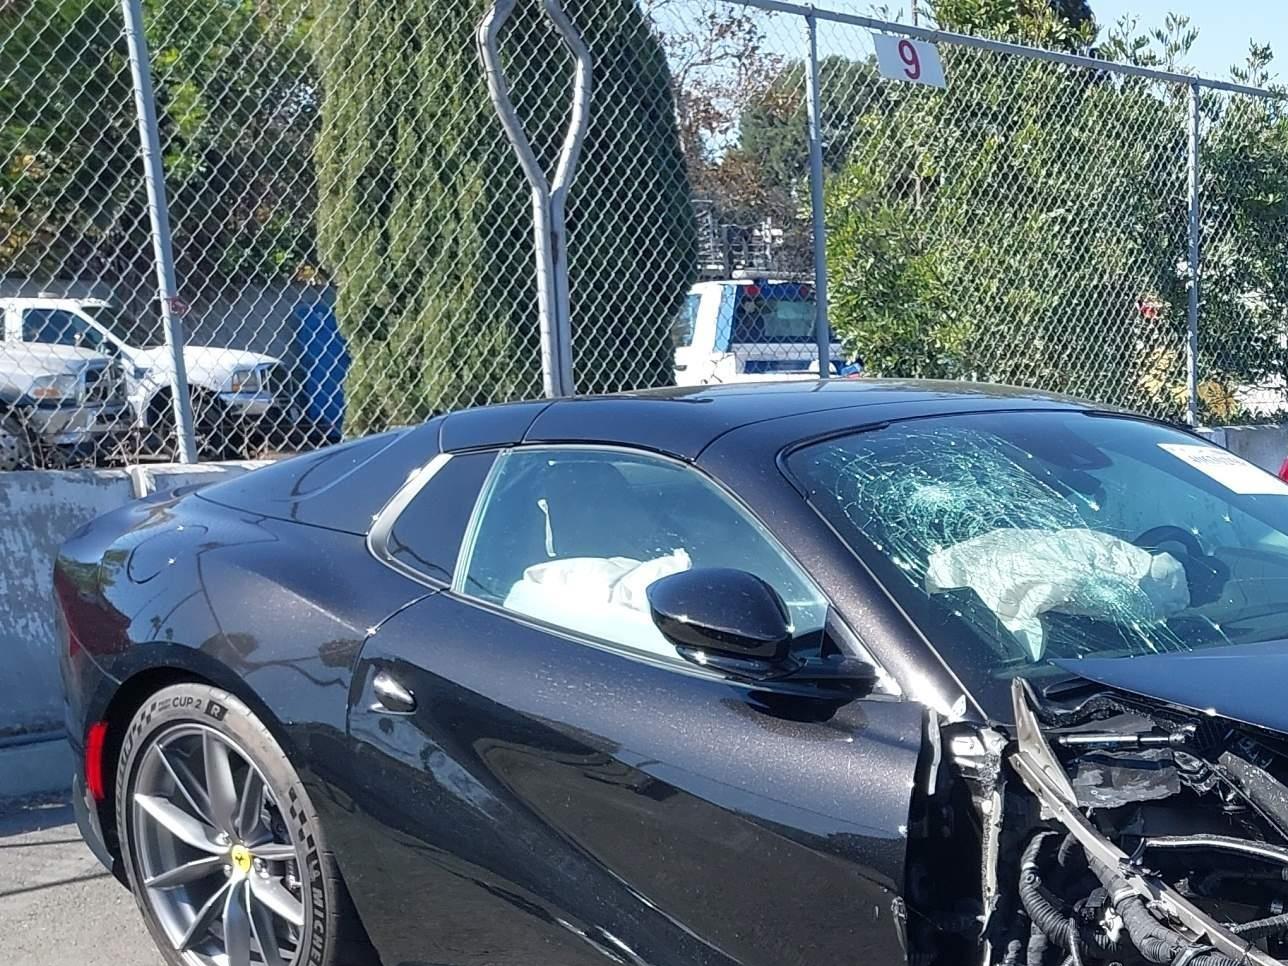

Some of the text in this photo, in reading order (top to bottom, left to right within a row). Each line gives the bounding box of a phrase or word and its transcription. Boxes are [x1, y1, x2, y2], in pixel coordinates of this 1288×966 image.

[898, 39, 921, 80] 9
[172, 696, 194, 708] CUP
[194, 698, 203, 710] 2
